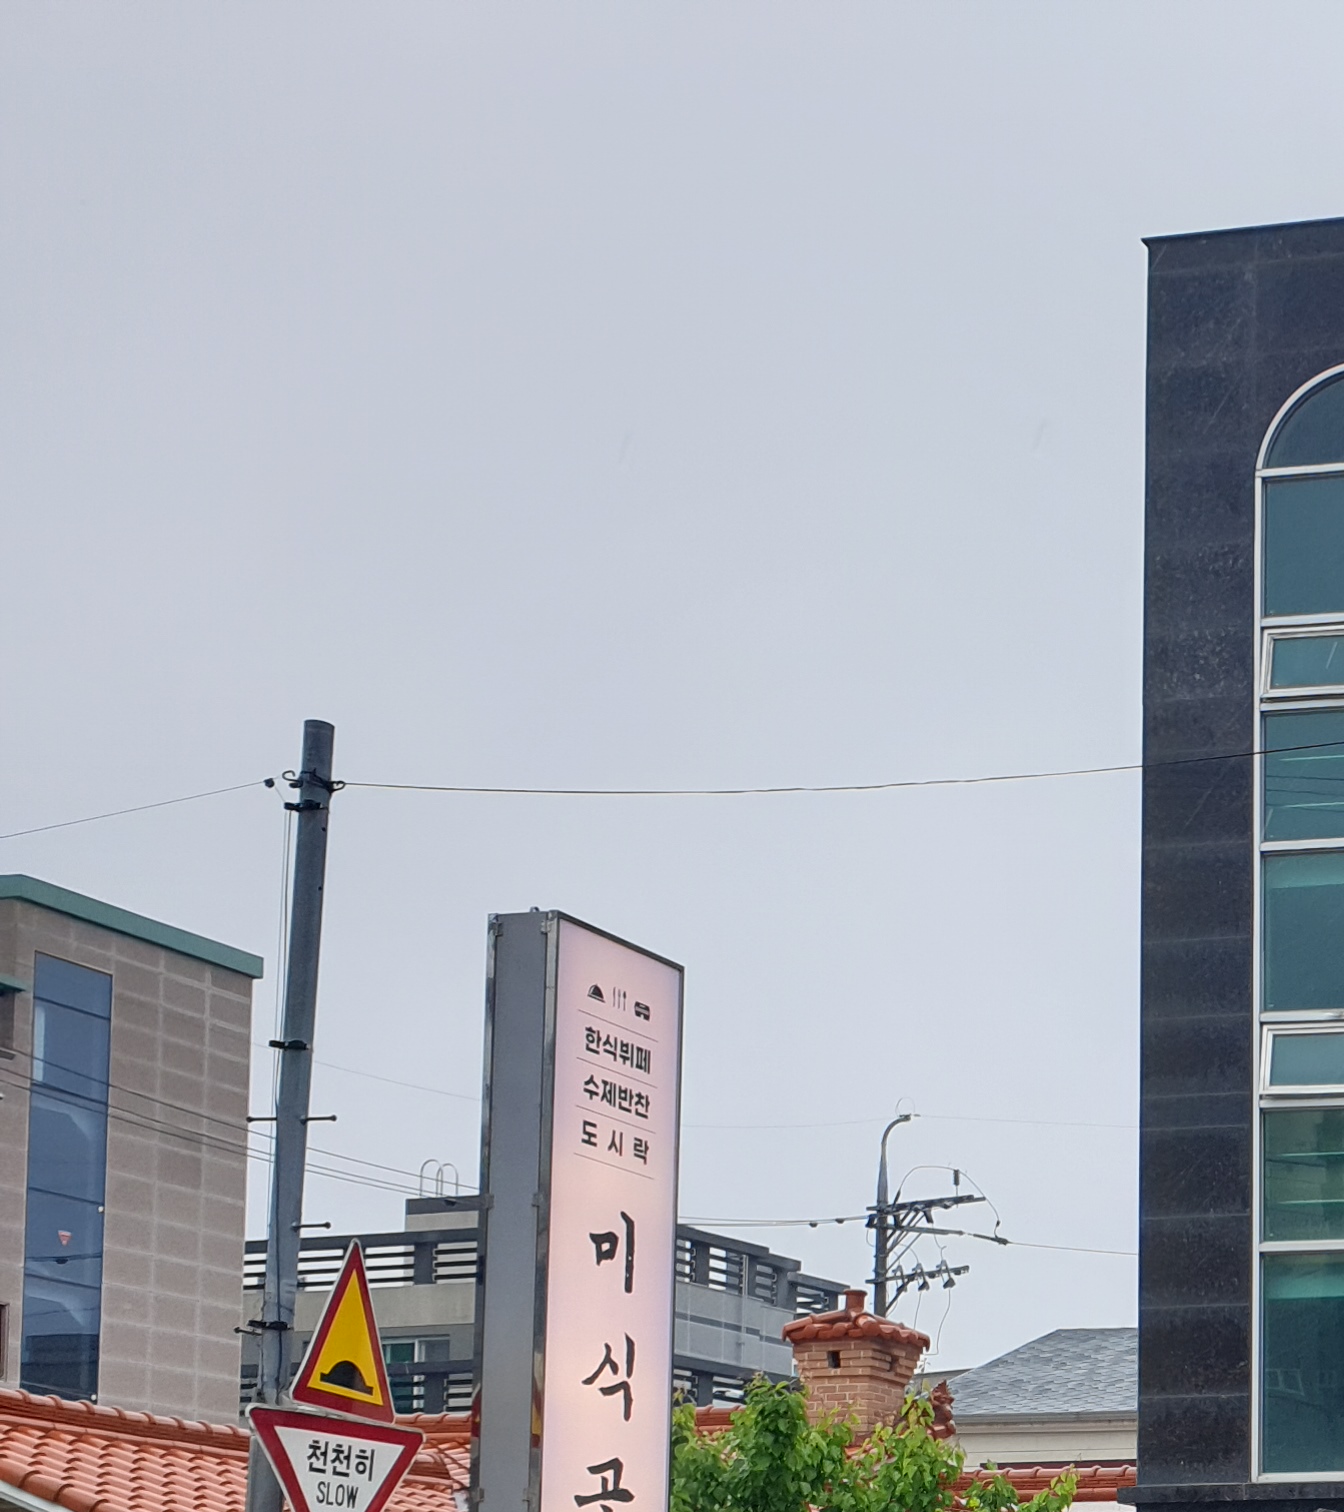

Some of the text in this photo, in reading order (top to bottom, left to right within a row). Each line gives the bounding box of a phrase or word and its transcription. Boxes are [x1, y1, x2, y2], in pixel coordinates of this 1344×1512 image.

[584, 1026, 651, 1075] 한식뷔페
[583, 1074, 650, 1119] 수제반찬
[306, 1440, 376, 1481] 천천히
[316, 1481, 358, 1509] SLOW
